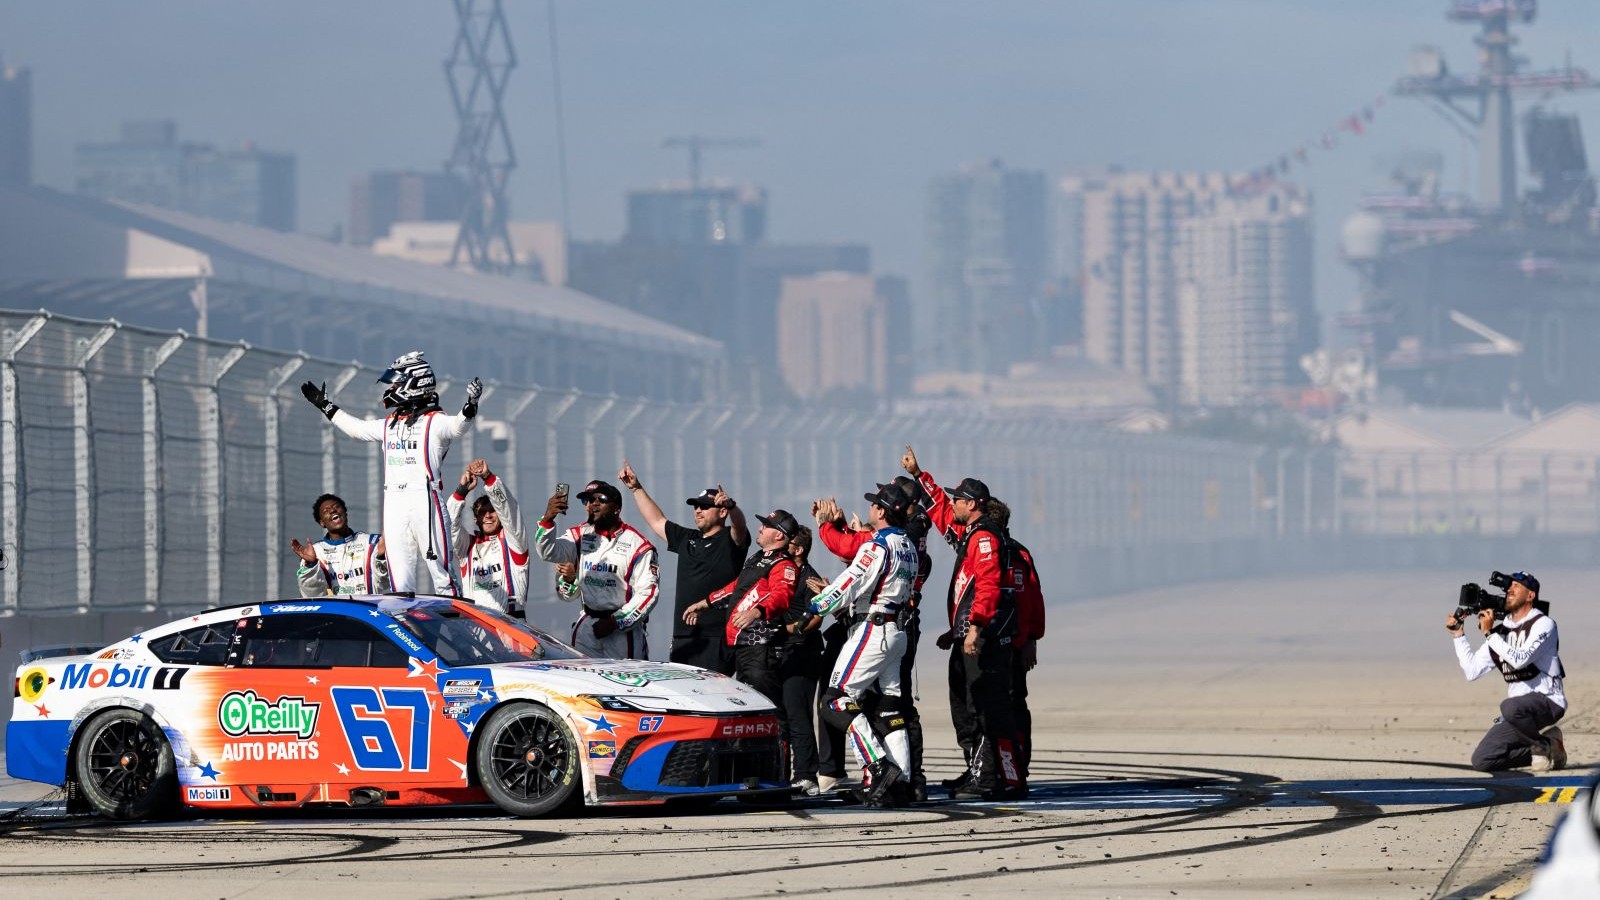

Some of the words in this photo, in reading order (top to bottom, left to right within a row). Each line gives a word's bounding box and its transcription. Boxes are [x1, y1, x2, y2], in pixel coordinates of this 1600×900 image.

[354, 567, 364, 577] 1
[492, 563, 502, 573] 1
[584, 561, 608, 573] Mobil
[608, 564, 618, 574] 1
[392, 627, 421, 652] Robinhood
[60, 663, 152, 690] Mobil
[222, 692, 315, 736] O'Reilly
[331, 686, 432, 773] 67
[638, 715, 664, 733] 67
[222, 742, 264, 762] AUTO
[266, 741, 320, 761] PARTS
[189, 787, 218, 800] Mobil
[219, 787, 231, 800] 1
